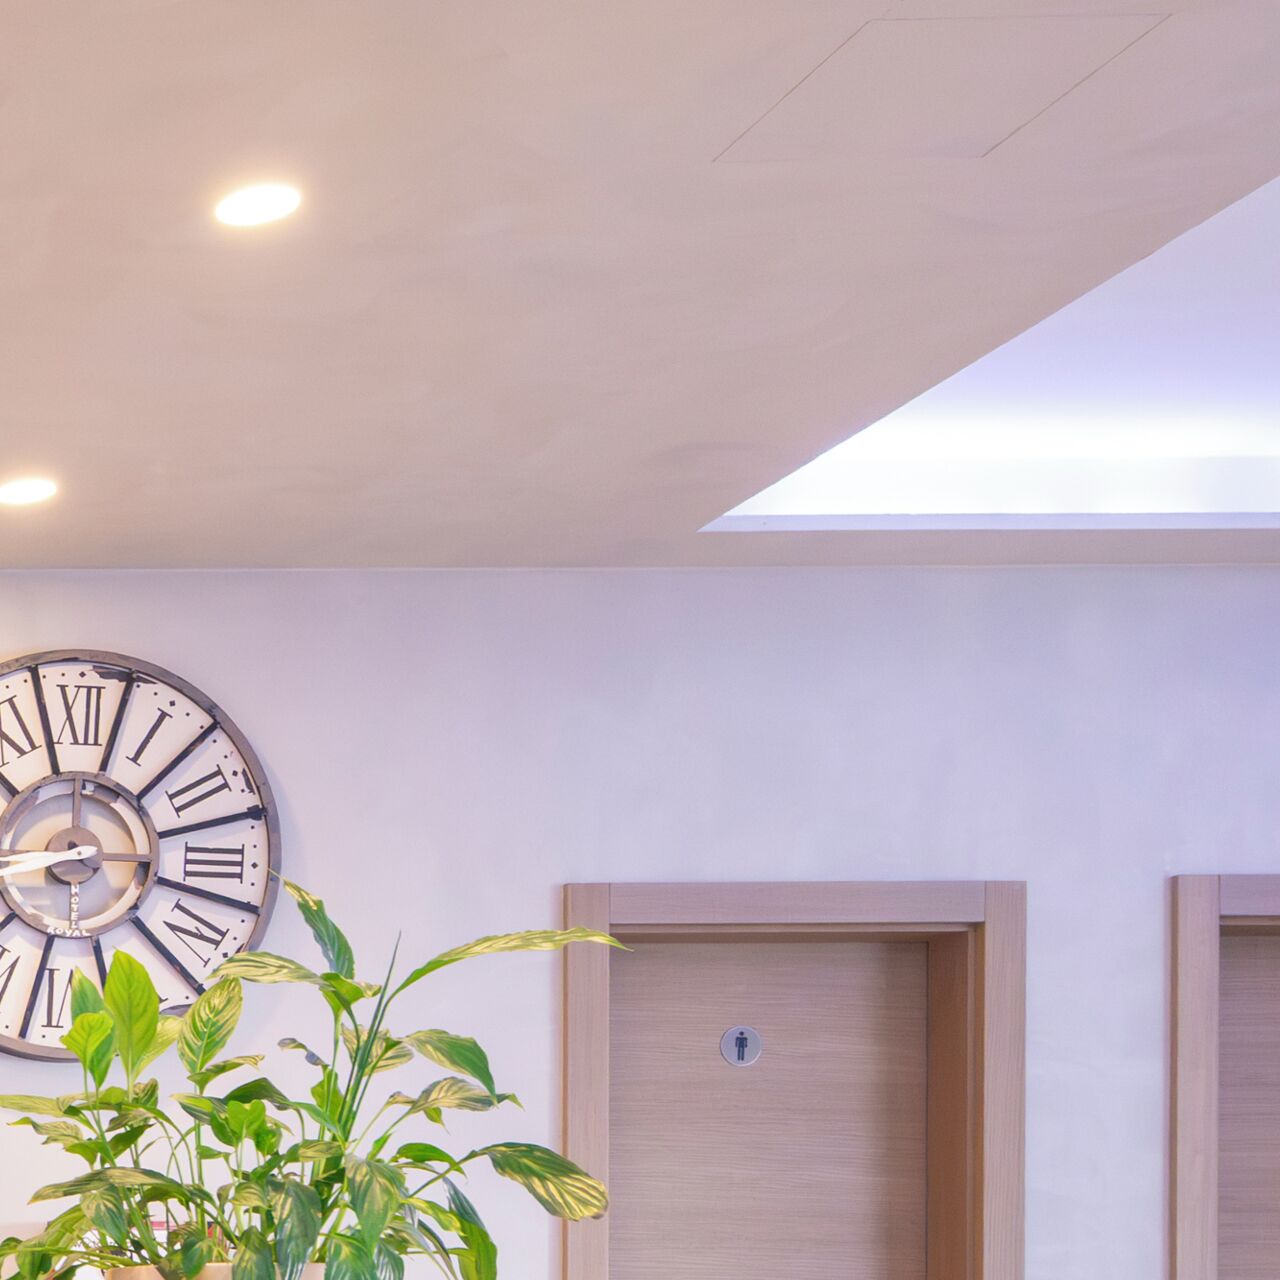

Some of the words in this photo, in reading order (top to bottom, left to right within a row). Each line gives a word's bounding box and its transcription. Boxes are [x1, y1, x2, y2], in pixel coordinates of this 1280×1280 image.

[52, 684, 106, 746] XII
[125, 707, 173, 766] I
[165, 764, 232, 818] II
[183, 841, 245, 884] III
[70, 884, 80, 928] HOTEL
[47, 926, 92, 937] ROYAL
